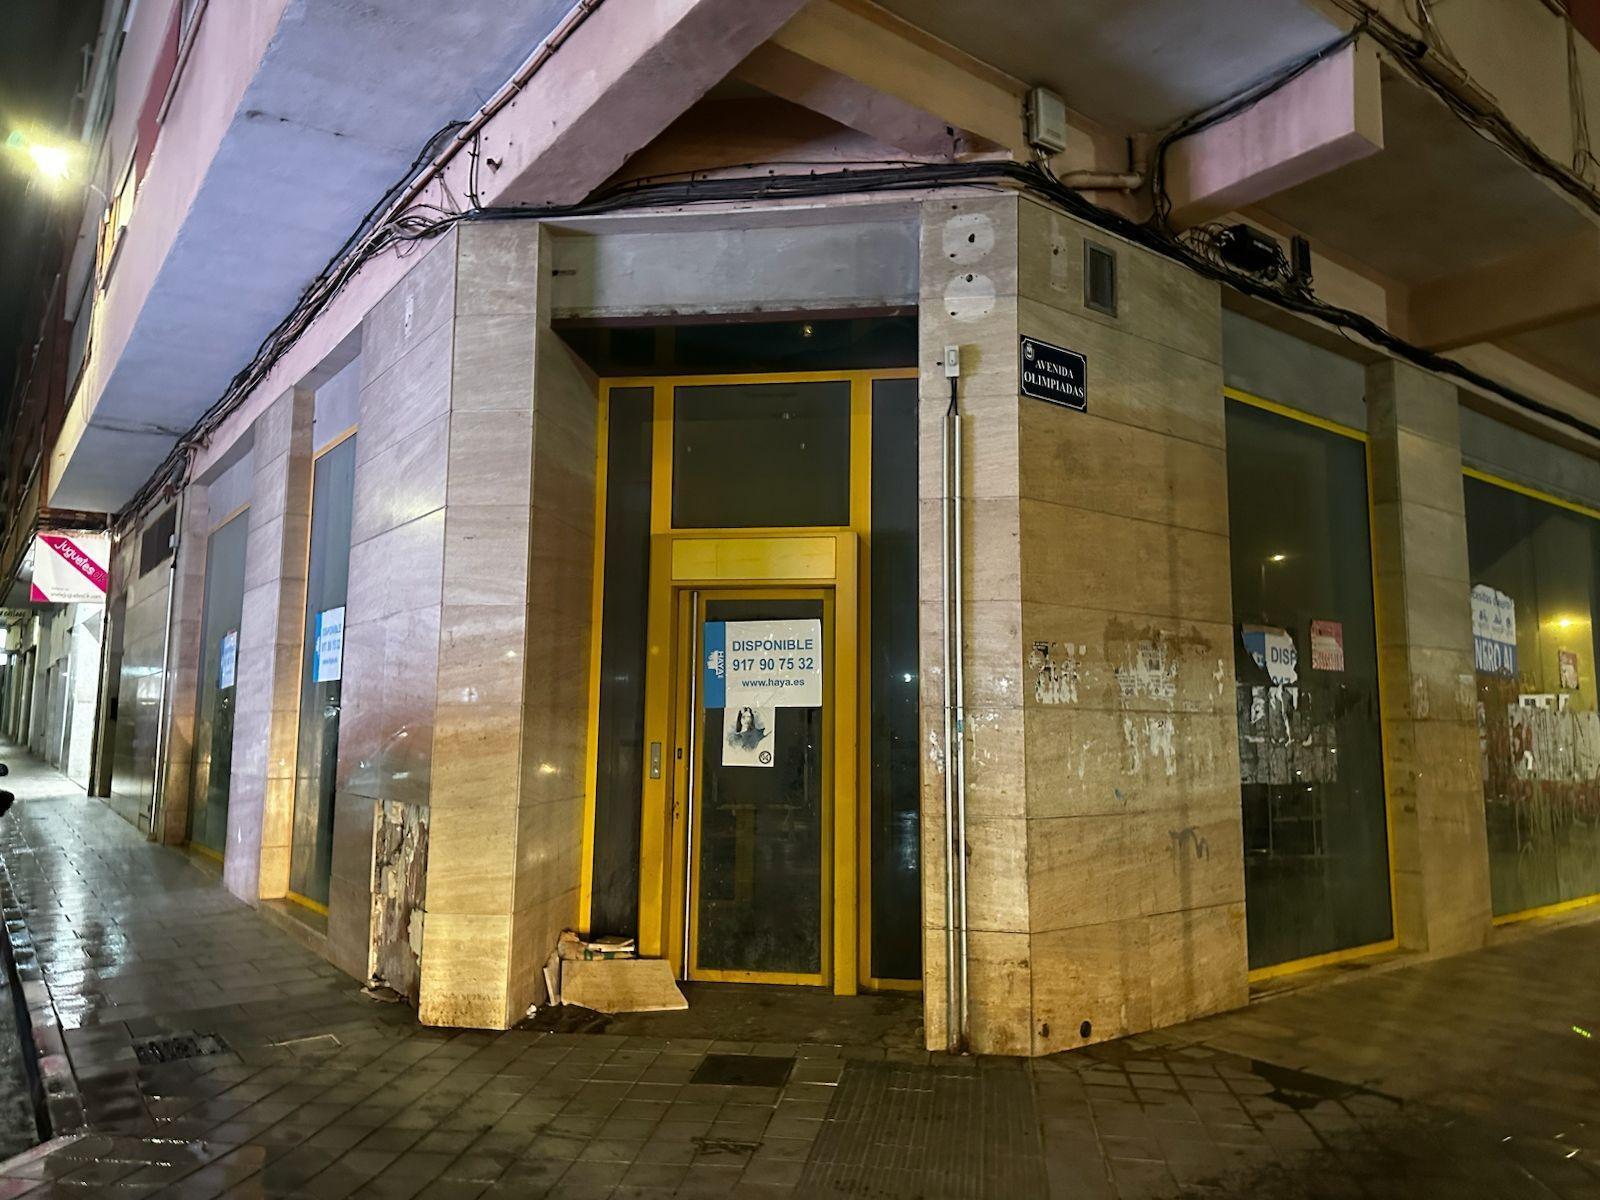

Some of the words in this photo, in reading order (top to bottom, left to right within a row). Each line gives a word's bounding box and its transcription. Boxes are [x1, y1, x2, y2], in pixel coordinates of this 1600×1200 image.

[1035, 359, 1074, 379] AVENIDA
[1024, 371, 1084, 398] OLIMPIADAS
[732, 640, 813, 652] DISPONIBLE
[732, 658, 754, 671] 917
[759, 658, 775, 671] 90
[779, 657, 794, 670] 75
[798, 657, 814, 670] 32
[1271, 647, 1297, 666] DISP
[741, 678, 805, 688] www.haya.es
